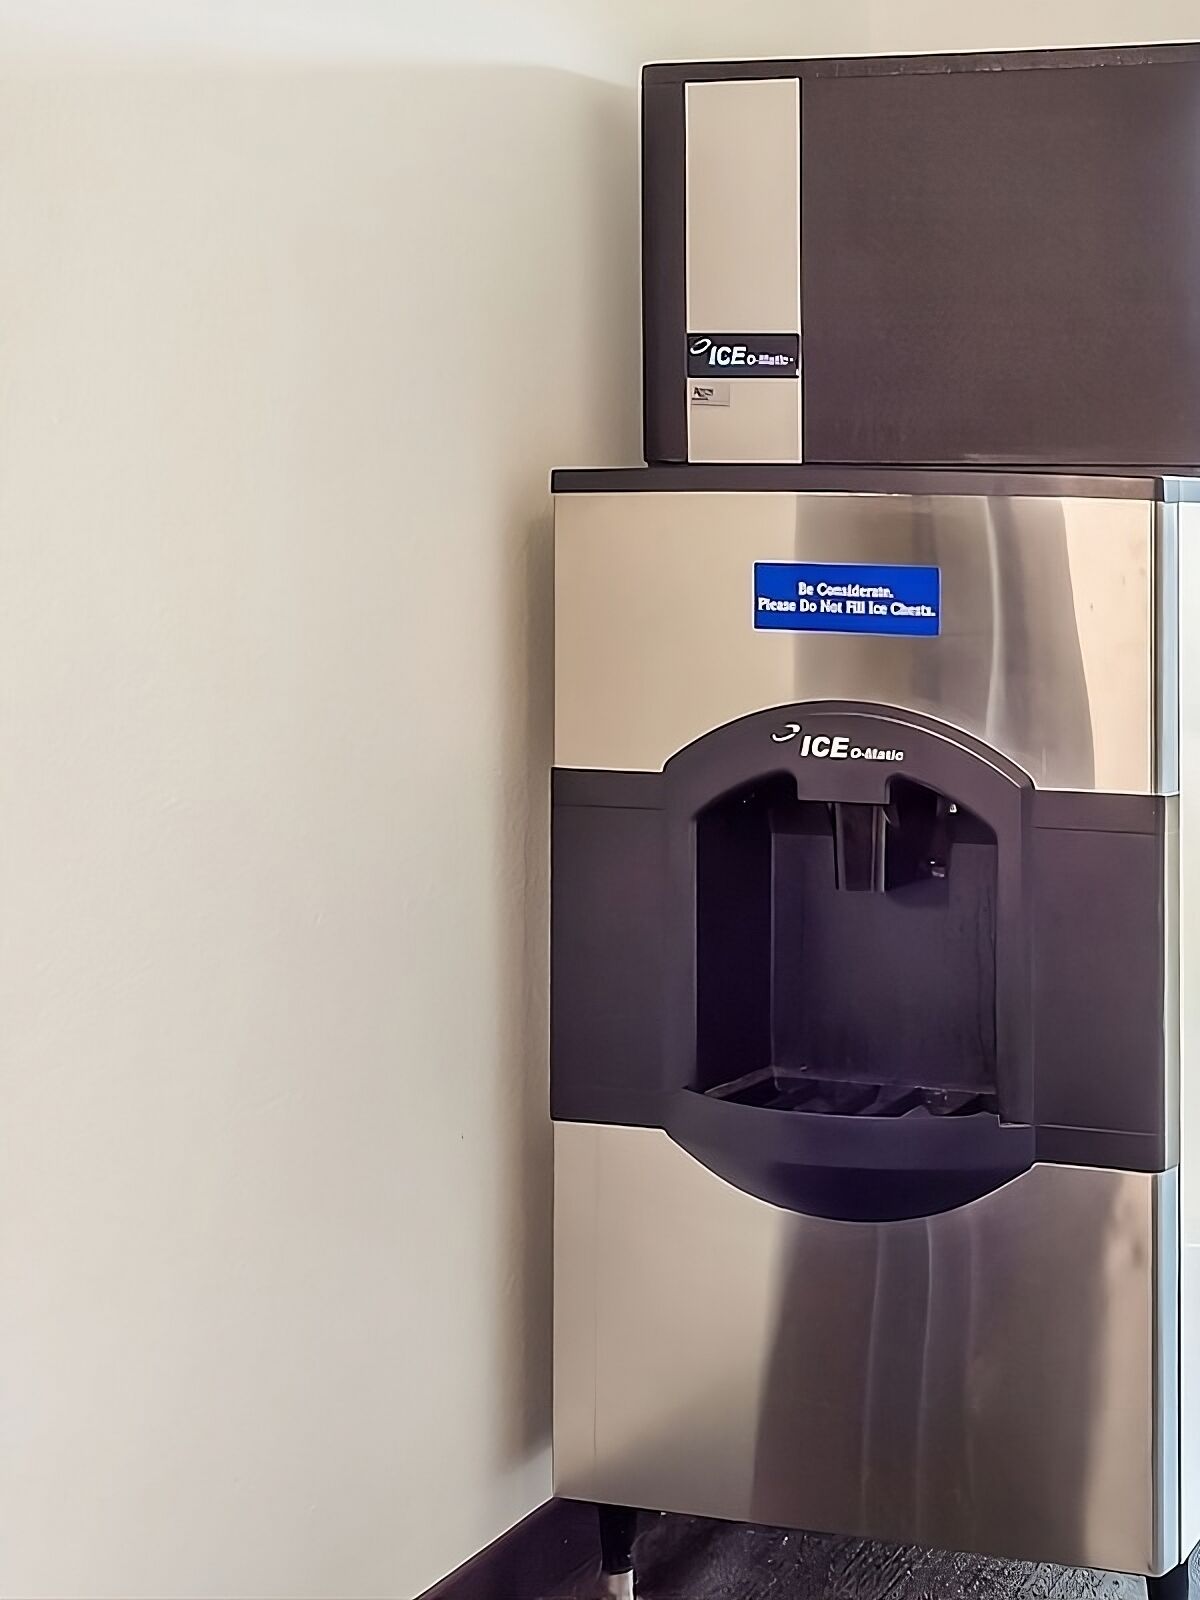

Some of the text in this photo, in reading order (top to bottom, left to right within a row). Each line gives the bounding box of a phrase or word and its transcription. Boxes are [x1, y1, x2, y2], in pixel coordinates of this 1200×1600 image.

[708, 345, 747, 366] ICE
[798, 581, 814, 596] Be
[757, 598, 796, 612] Please
[799, 599, 817, 613] Do
[820, 599, 843, 614] Not
[845, 601, 866, 614] Fill
[868, 601, 888, 615] Ice
[800, 735, 850, 759] ICE
